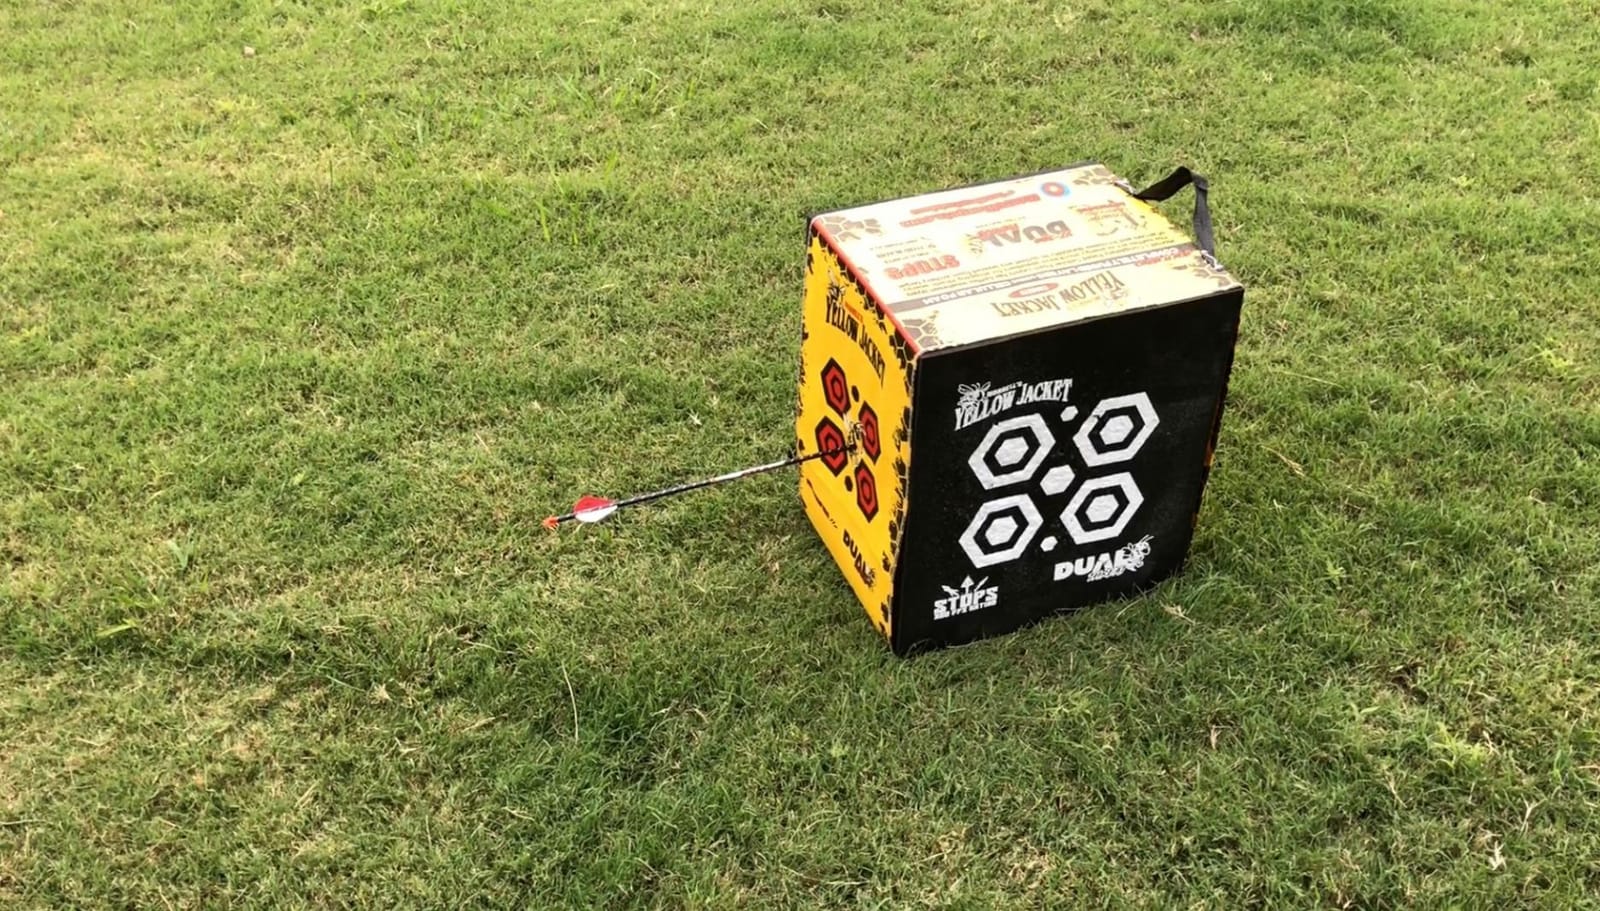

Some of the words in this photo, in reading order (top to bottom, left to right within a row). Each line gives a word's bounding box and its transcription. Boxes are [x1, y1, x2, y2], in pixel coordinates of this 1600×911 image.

[975, 219, 1071, 247] DUAL
[882, 254, 960, 279] STOPS
[1054, 270, 1125, 303] YELLOW
[989, 294, 1060, 317] JACKET
[825, 296, 858, 337] YELLOW
[859, 327, 886, 389] JACKET
[954, 390, 1016, 431] YELLOW
[1016, 378, 1073, 404] JACKET
[842, 529, 874, 586] DUAL
[1052, 549, 1128, 581] DUAL
[934, 586, 999, 611] STOPS
